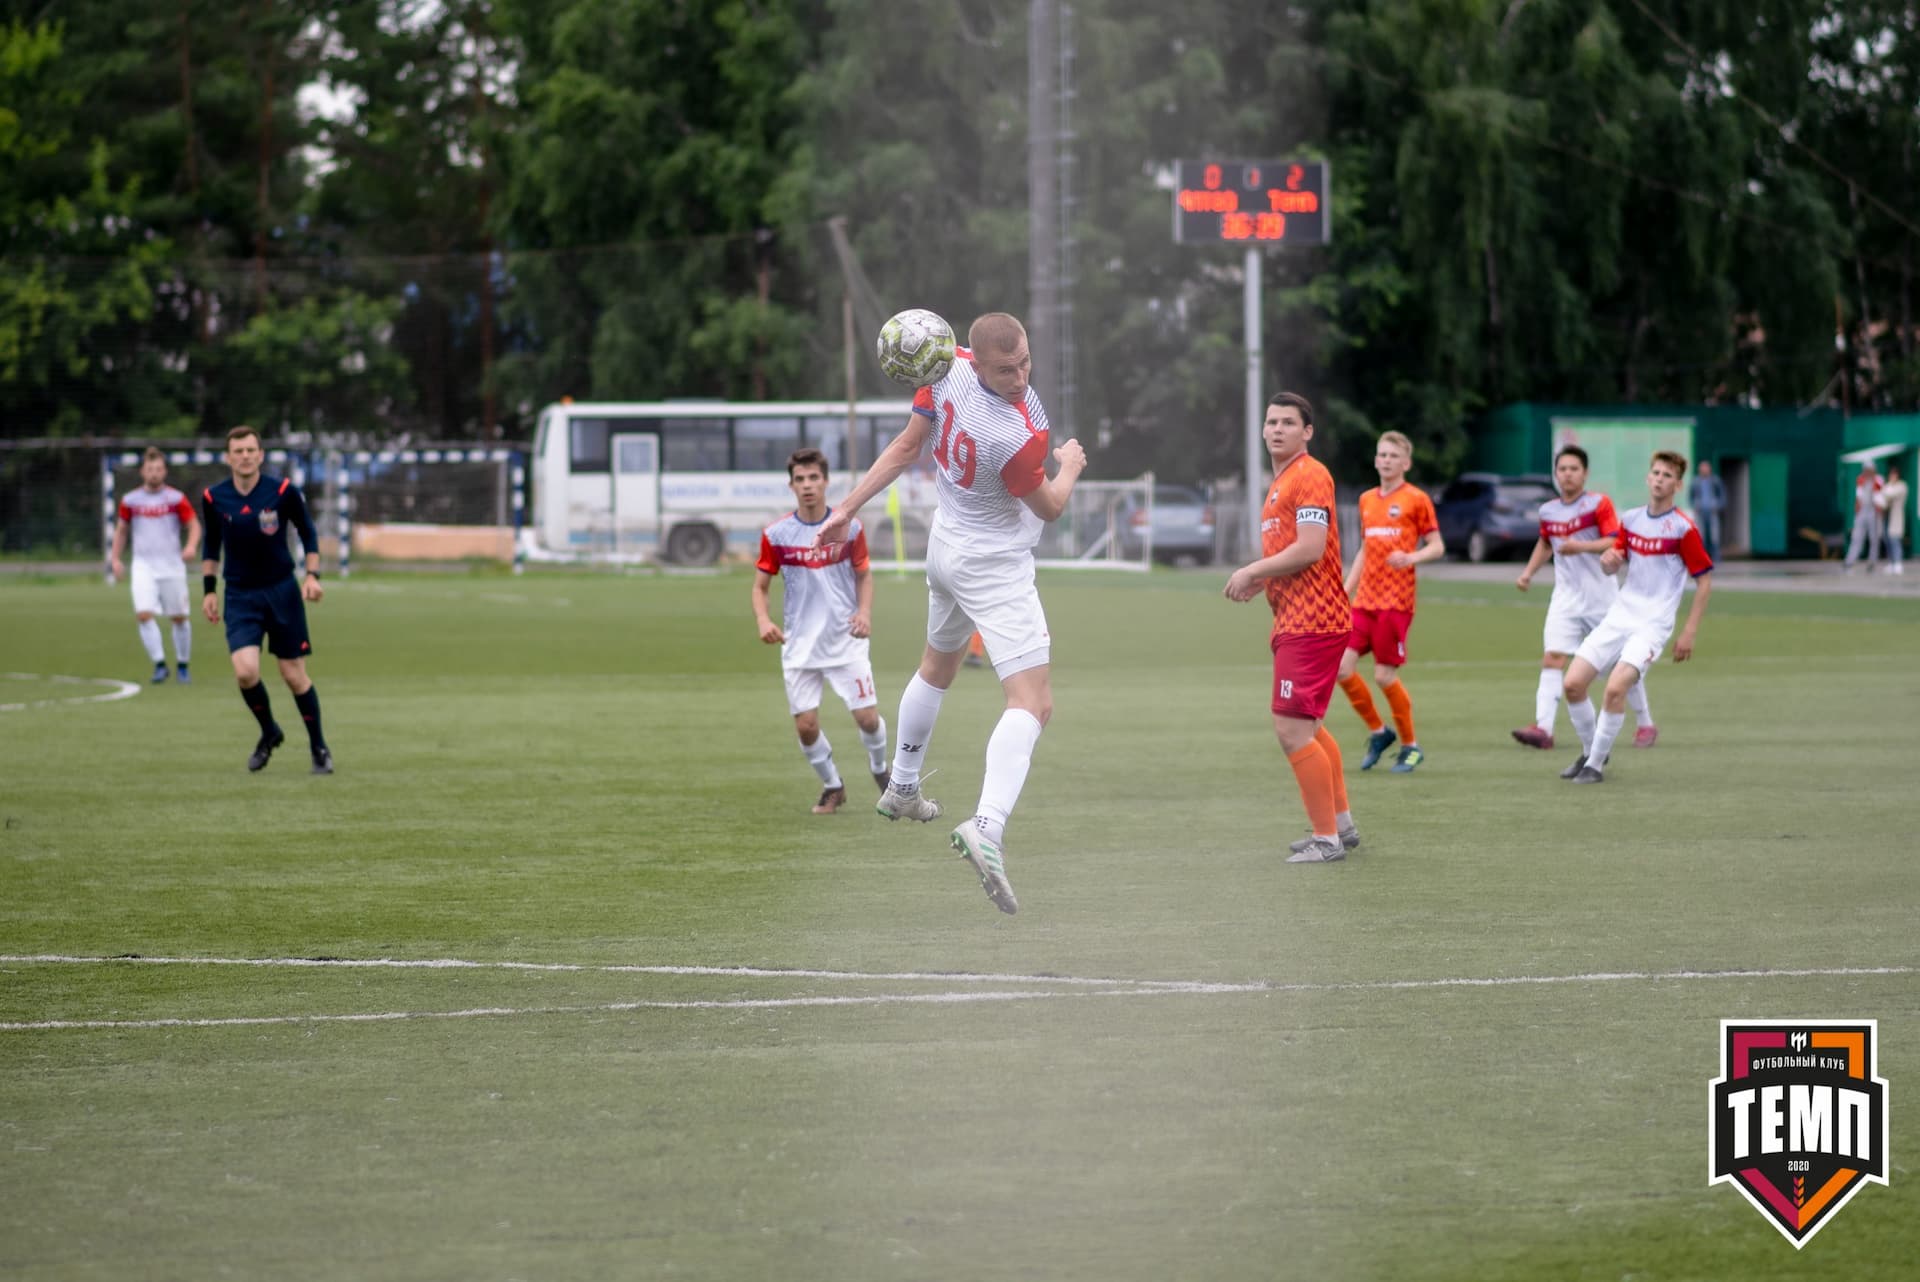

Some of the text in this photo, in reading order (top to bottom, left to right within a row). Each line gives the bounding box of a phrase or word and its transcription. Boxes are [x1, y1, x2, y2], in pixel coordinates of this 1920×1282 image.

[1286, 164, 1305, 190] 2
[933, 400, 977, 489] 19
[1296, 510, 1328, 521] APTA
[1280, 679, 1293, 699] 13
